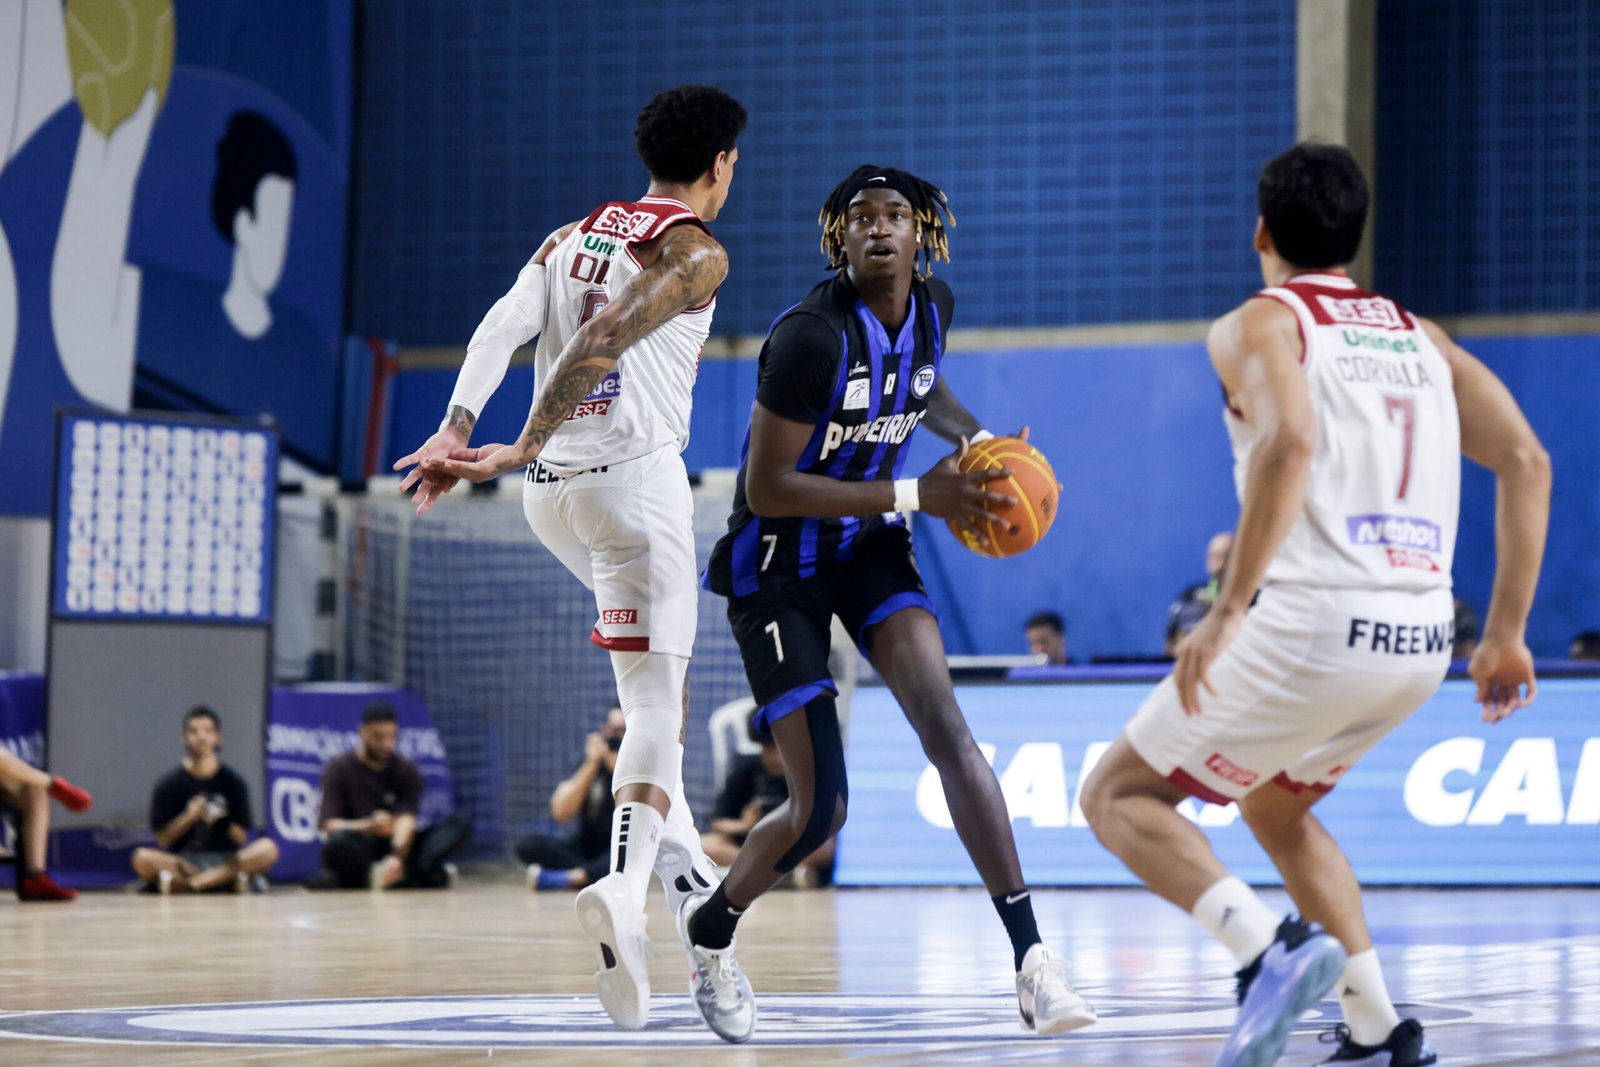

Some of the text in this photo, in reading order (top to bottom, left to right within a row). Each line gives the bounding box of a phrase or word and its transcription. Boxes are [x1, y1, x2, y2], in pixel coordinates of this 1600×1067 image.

[1333, 301, 1394, 322] SESI
[1381, 393, 1416, 501] 7
[761, 535, 777, 571] 7
[604, 610, 633, 624] SESI
